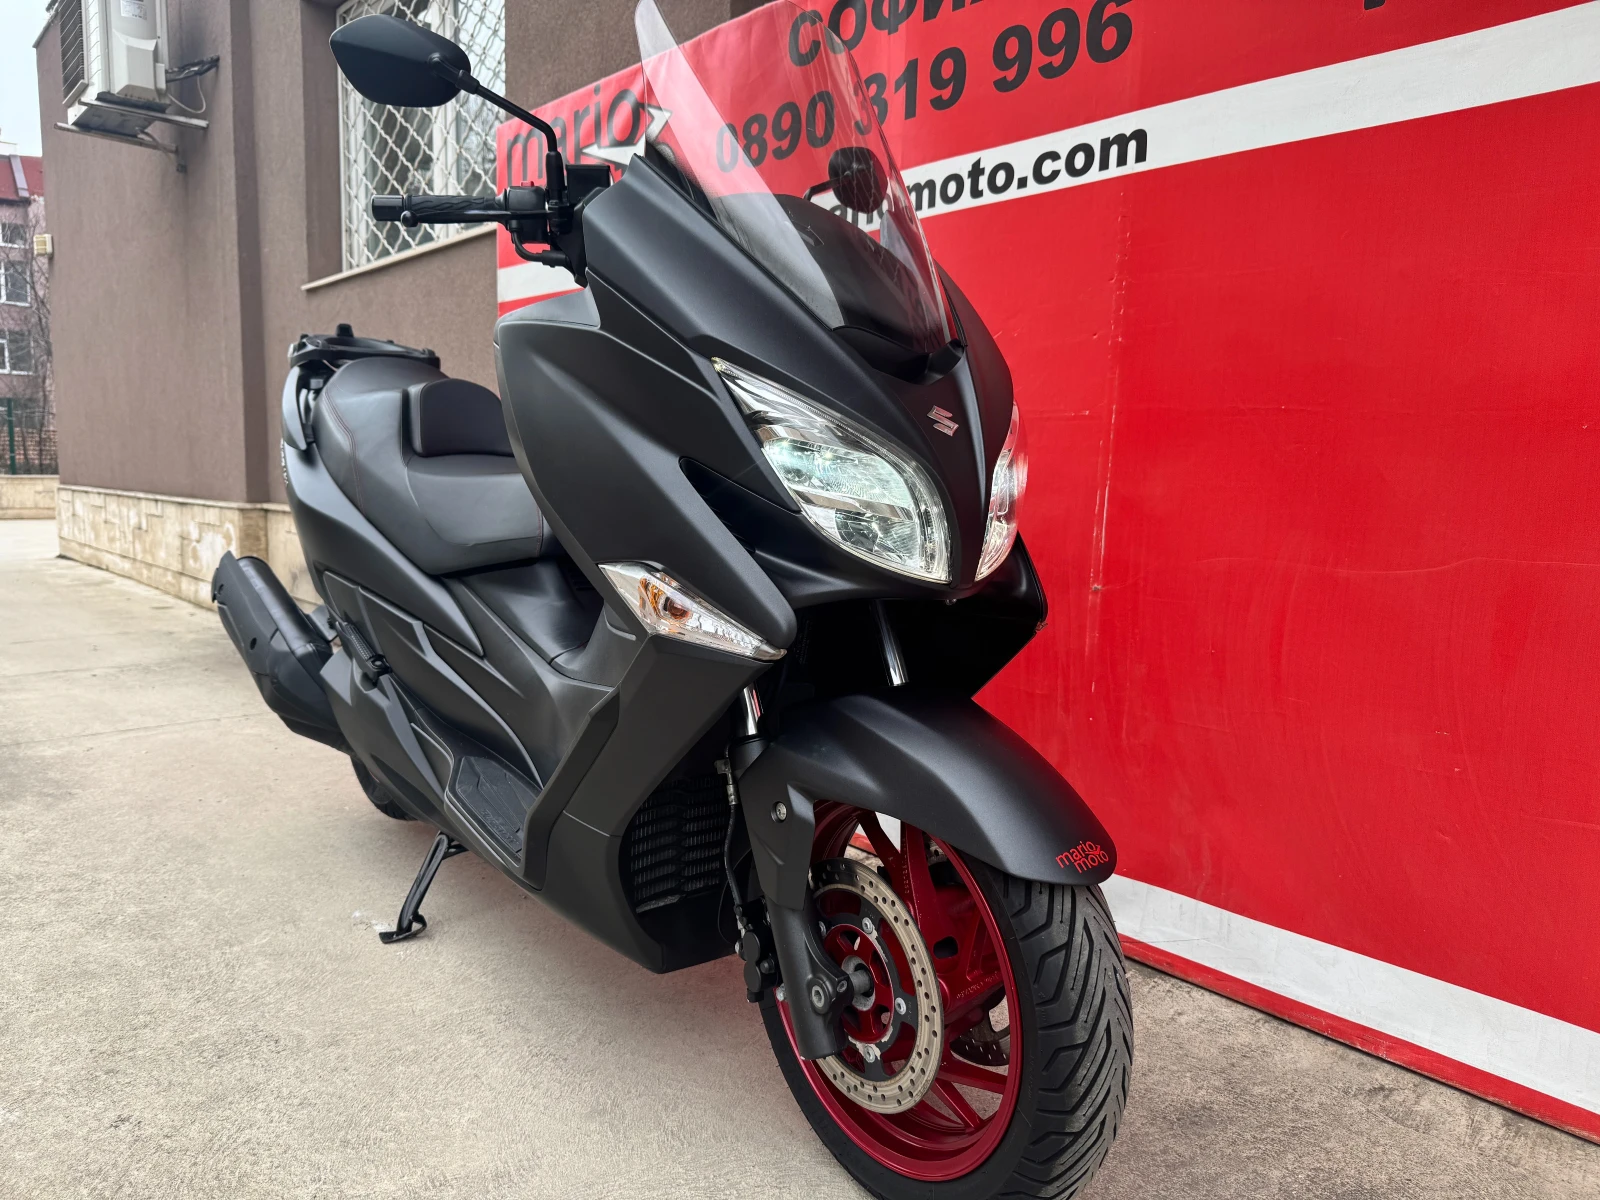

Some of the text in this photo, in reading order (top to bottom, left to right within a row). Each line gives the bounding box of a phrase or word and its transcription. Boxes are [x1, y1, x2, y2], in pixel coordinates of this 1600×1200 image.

[716, 0, 1133, 173] 0890 319 996
[1055, 841, 1096, 868] mario
